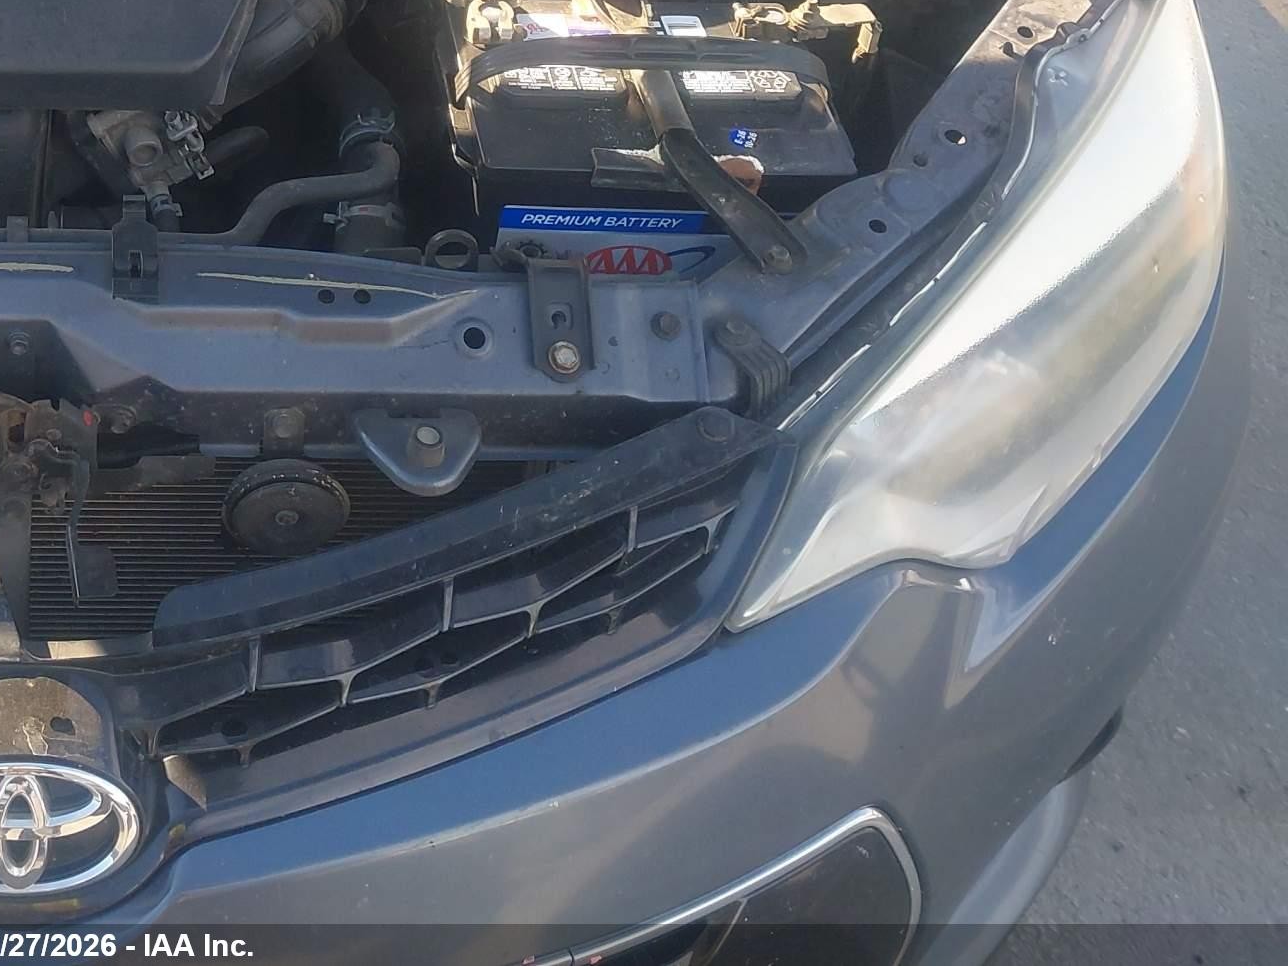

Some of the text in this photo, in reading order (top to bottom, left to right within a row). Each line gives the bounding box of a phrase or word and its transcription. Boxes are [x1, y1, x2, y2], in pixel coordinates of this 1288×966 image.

[521, 213, 685, 229] PREMIUM BATTERY
[587, 246, 665, 275] AAA
